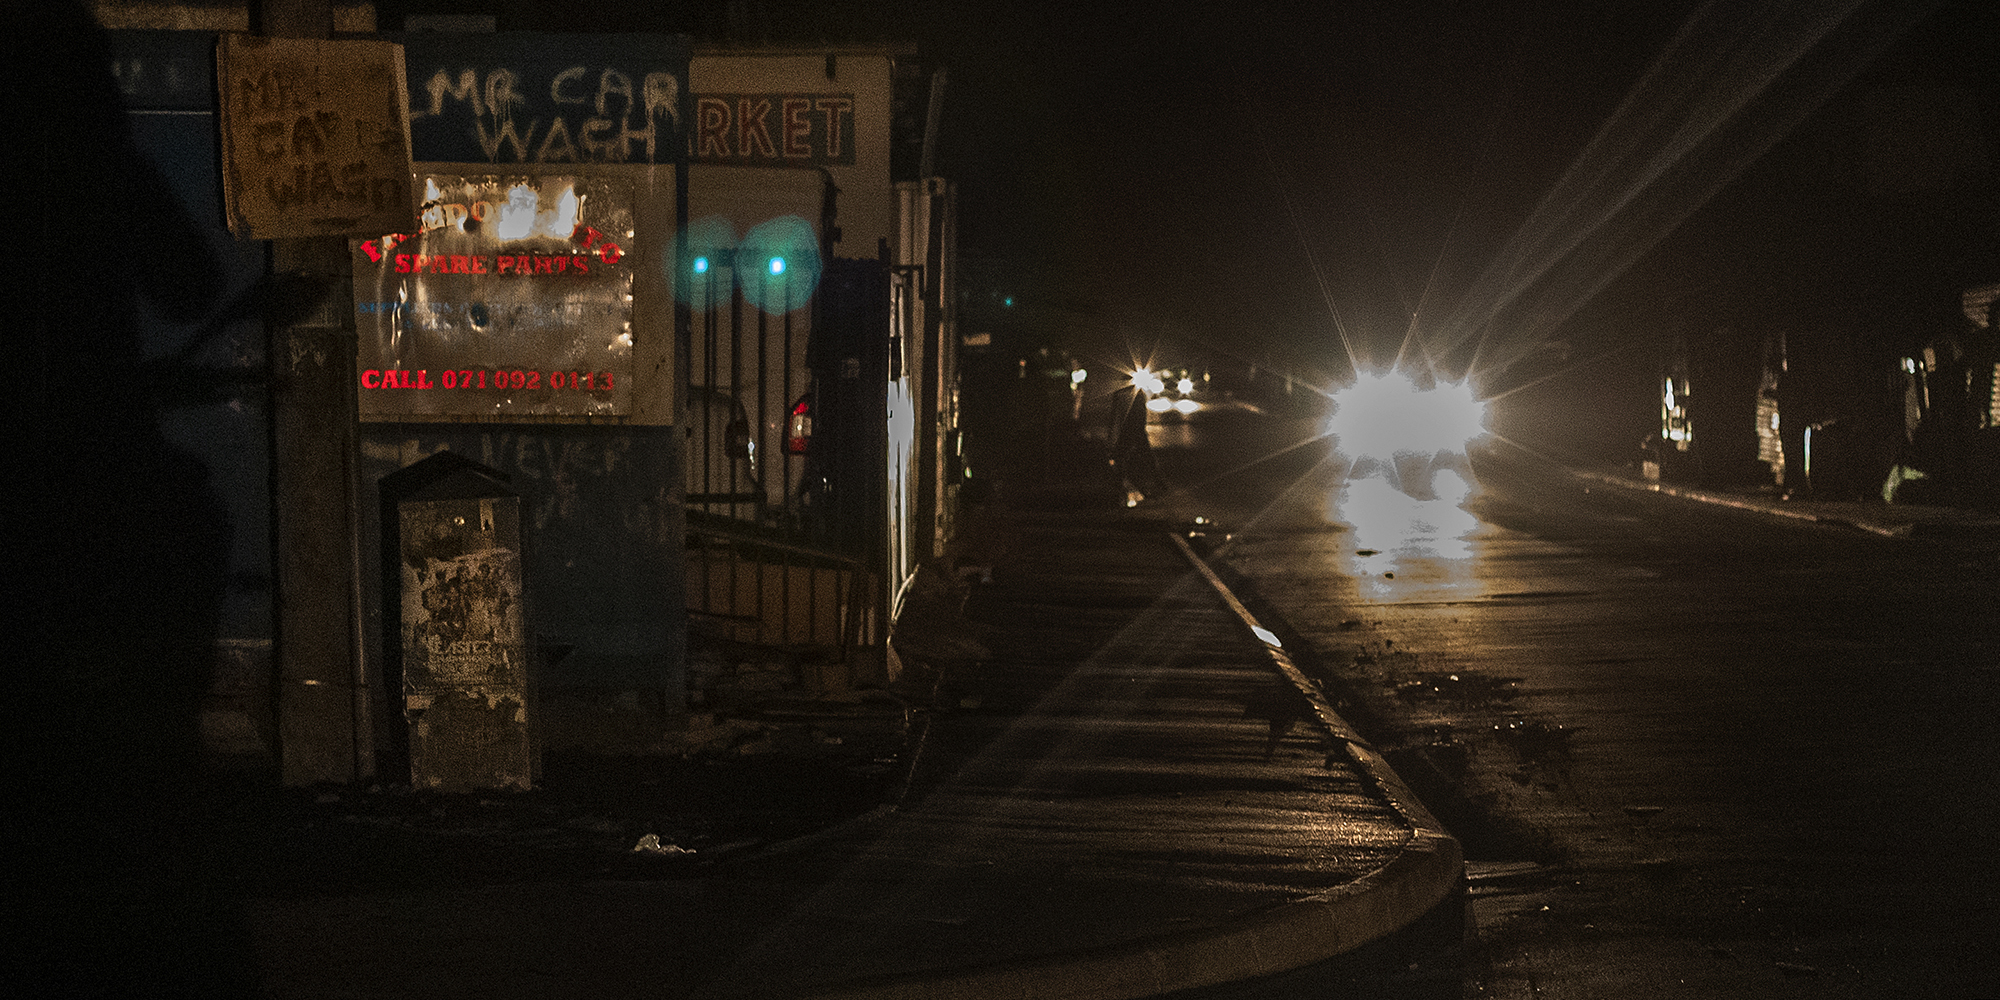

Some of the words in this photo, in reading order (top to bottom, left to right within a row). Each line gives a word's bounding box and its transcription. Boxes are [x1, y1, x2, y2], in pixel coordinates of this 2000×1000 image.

[424, 67, 525, 117] MR
[551, 66, 679, 127] CAR
[688, 98, 852, 158] RKET
[394, 253, 488, 274] SPARE
[497, 255, 589, 275] PARTS
[361, 369, 433, 390] CALL
[442, 370, 487, 390] 071
[494, 370, 541, 390] 092
[550, 371, 614, 391] 0113
